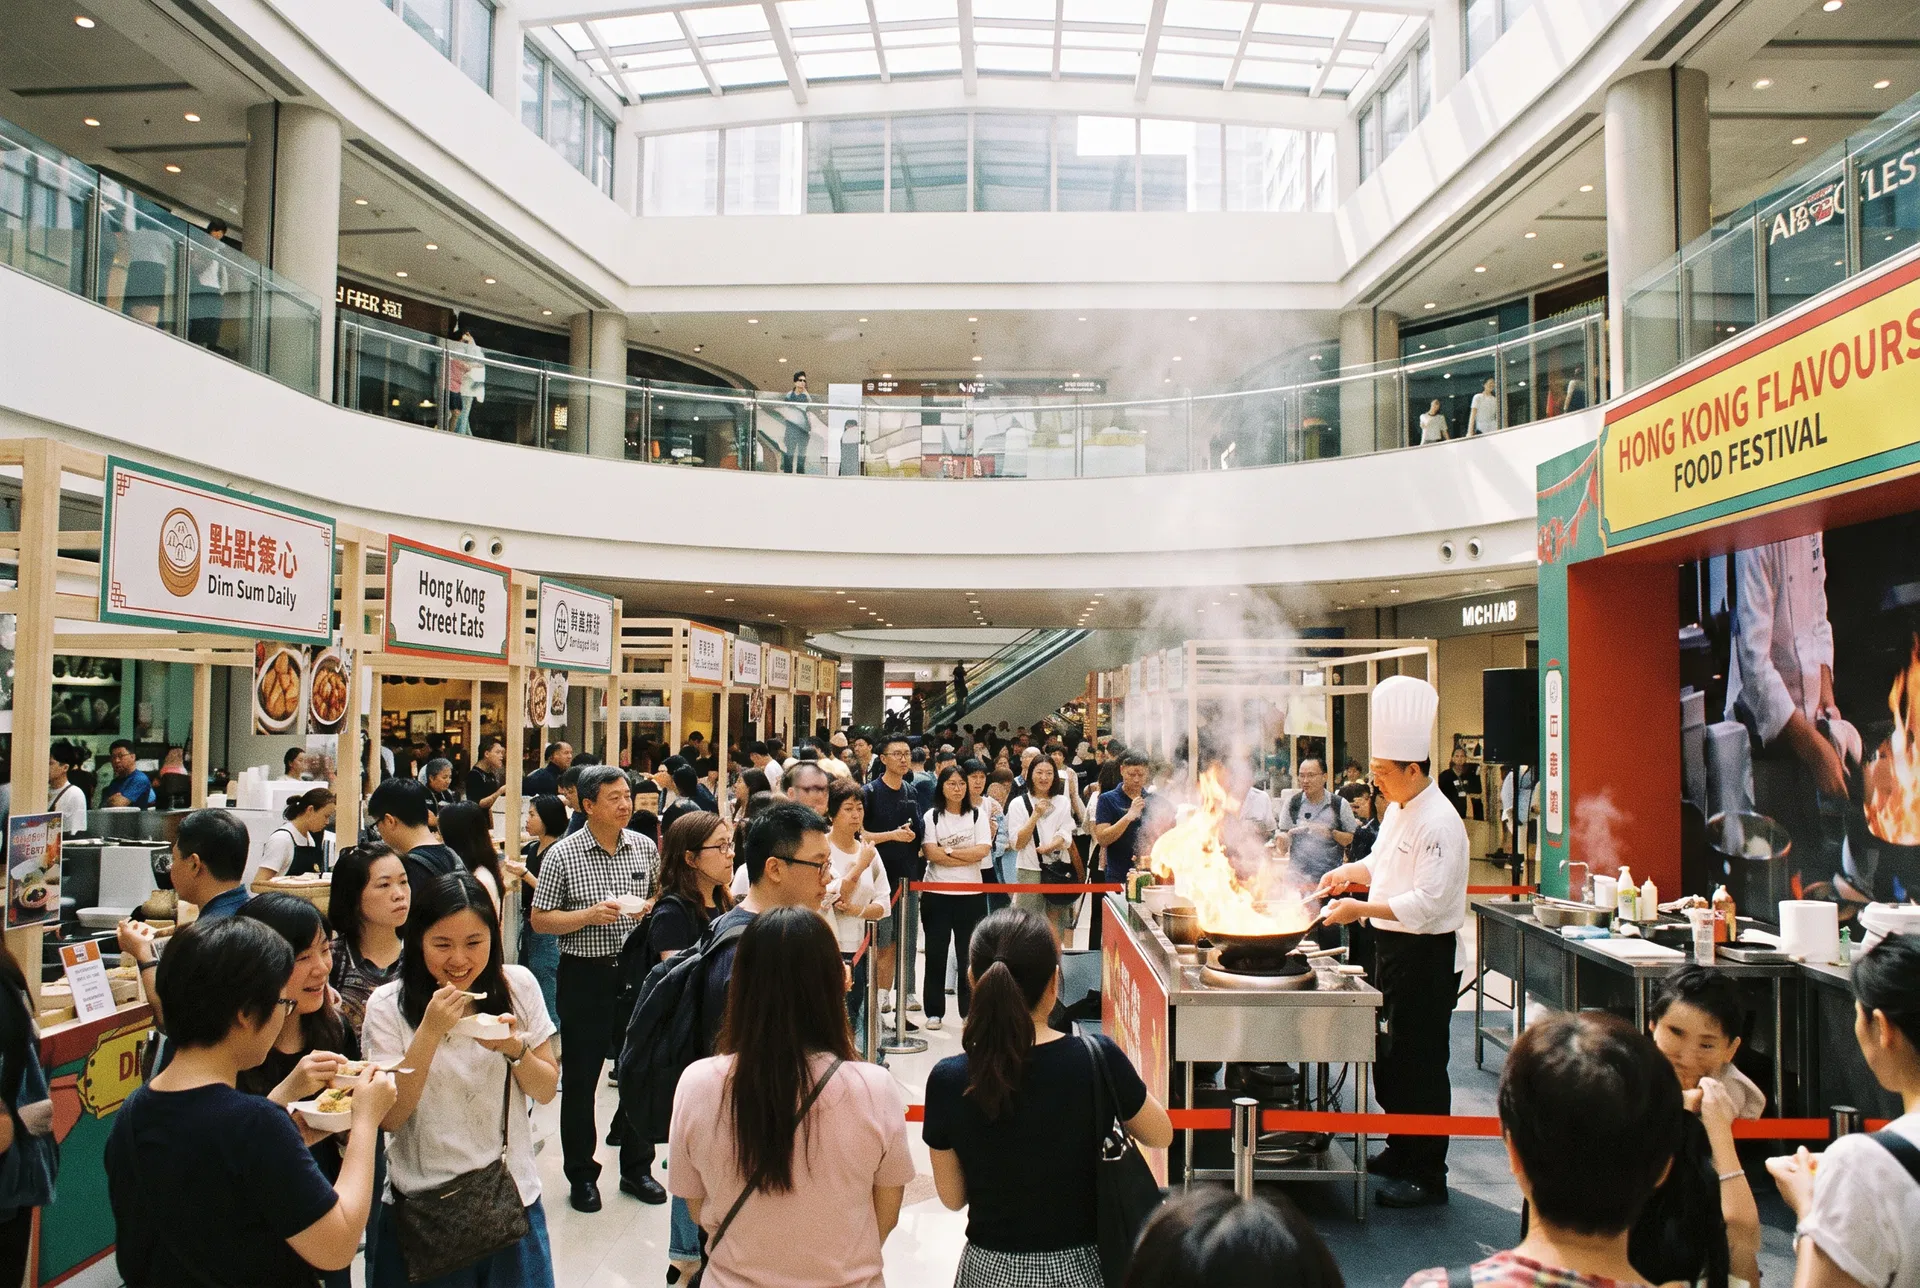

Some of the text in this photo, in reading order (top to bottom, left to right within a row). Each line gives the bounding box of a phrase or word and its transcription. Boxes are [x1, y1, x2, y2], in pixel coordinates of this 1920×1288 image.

[1619, 308, 1920, 473] HONG KONG FLAVOURS
[1674, 412, 1828, 493] FOOD FESTIVAL
[208, 574, 297, 612] Dim Sum Daily
[419, 570, 486, 614] Hong Kong
[418, 605, 484, 639] Street Eats
[119, 1041, 144, 1082] DI
